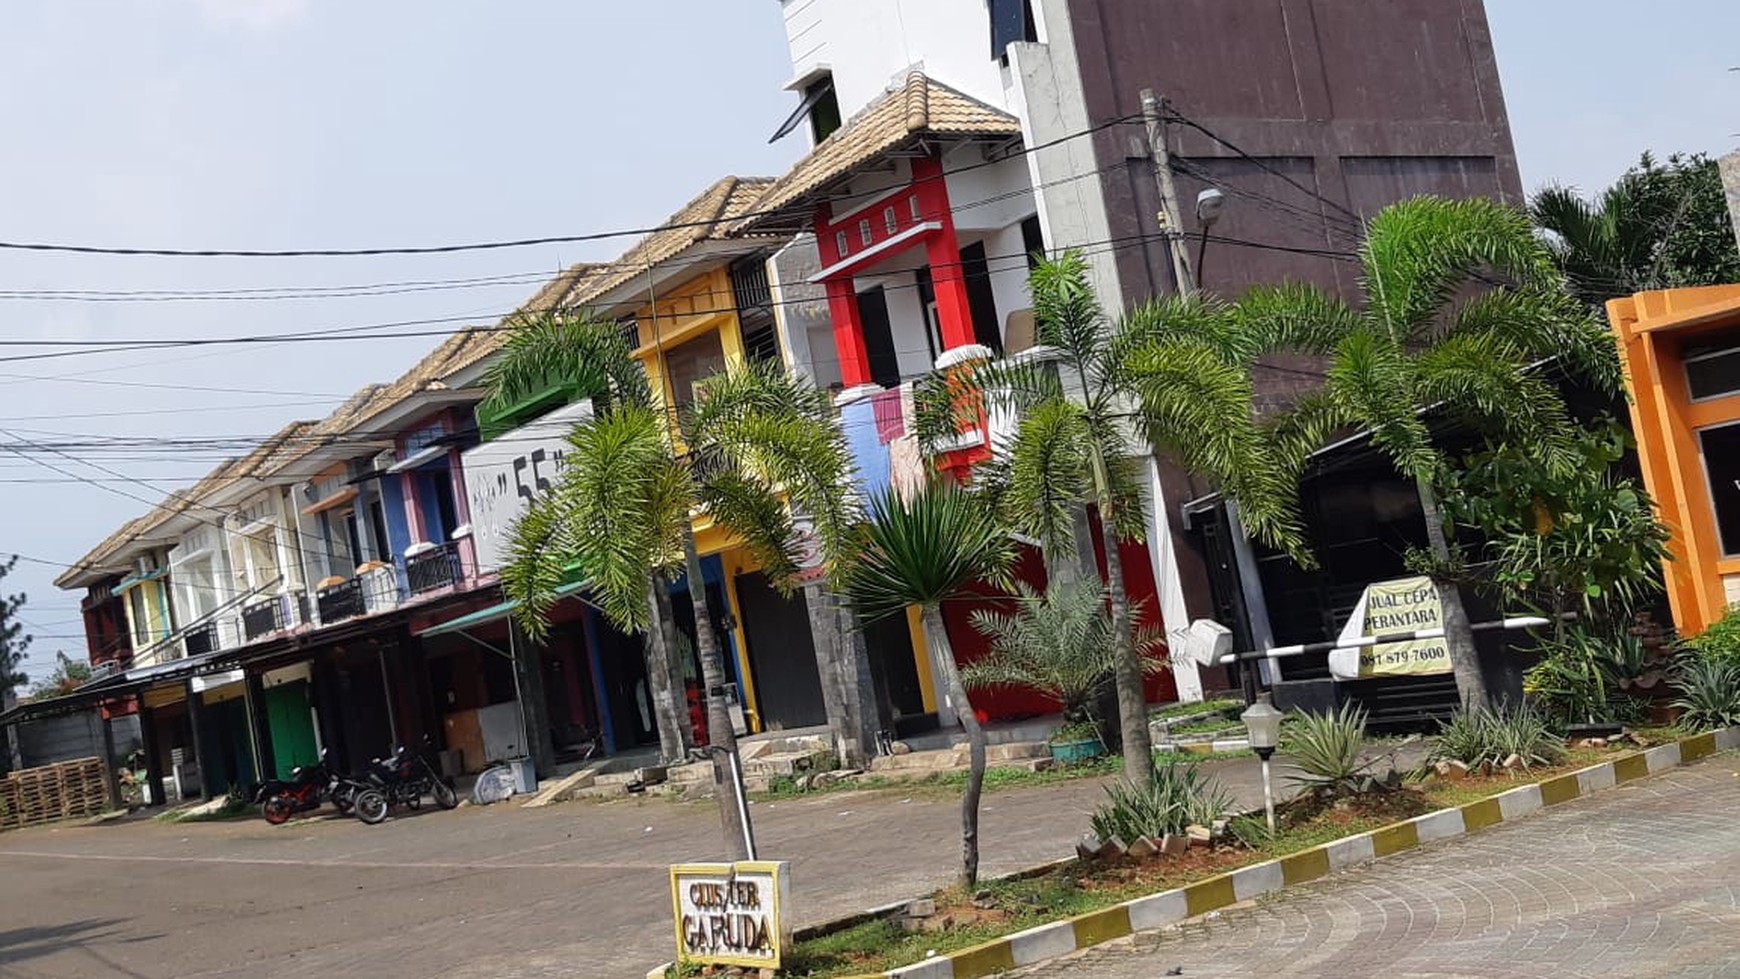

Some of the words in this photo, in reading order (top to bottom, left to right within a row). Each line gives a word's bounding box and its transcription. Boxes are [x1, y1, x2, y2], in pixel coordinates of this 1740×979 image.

[1371, 594, 1402, 609] JUAL
[1364, 608, 1437, 630] PERANTARA
[682, 913, 774, 954] GARUDA
